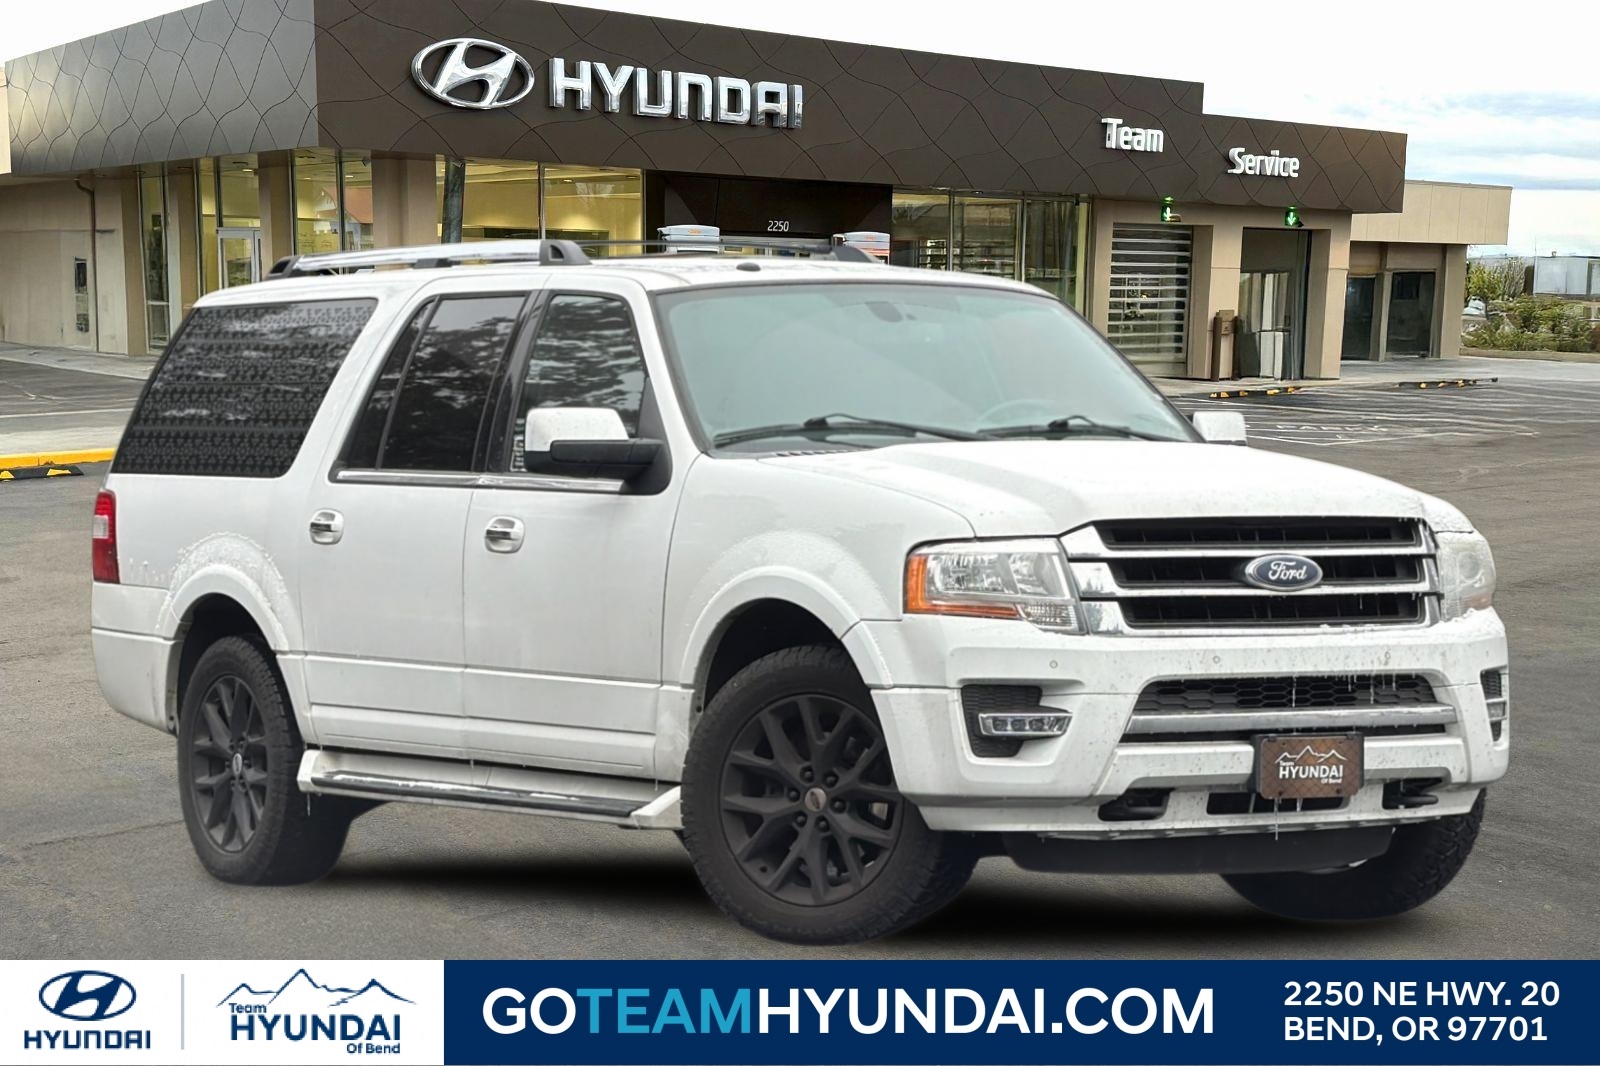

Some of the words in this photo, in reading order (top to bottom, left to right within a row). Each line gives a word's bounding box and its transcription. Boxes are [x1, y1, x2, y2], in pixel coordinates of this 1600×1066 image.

[548, 57, 804, 129] HYUNDAI
[1101, 117, 1164, 153] Team
[1227, 146, 1301, 178] Service
[767, 220, 790, 232] 2250
[1268, 560, 1308, 581] Ford
[1279, 764, 1344, 779] HYUNDAI
